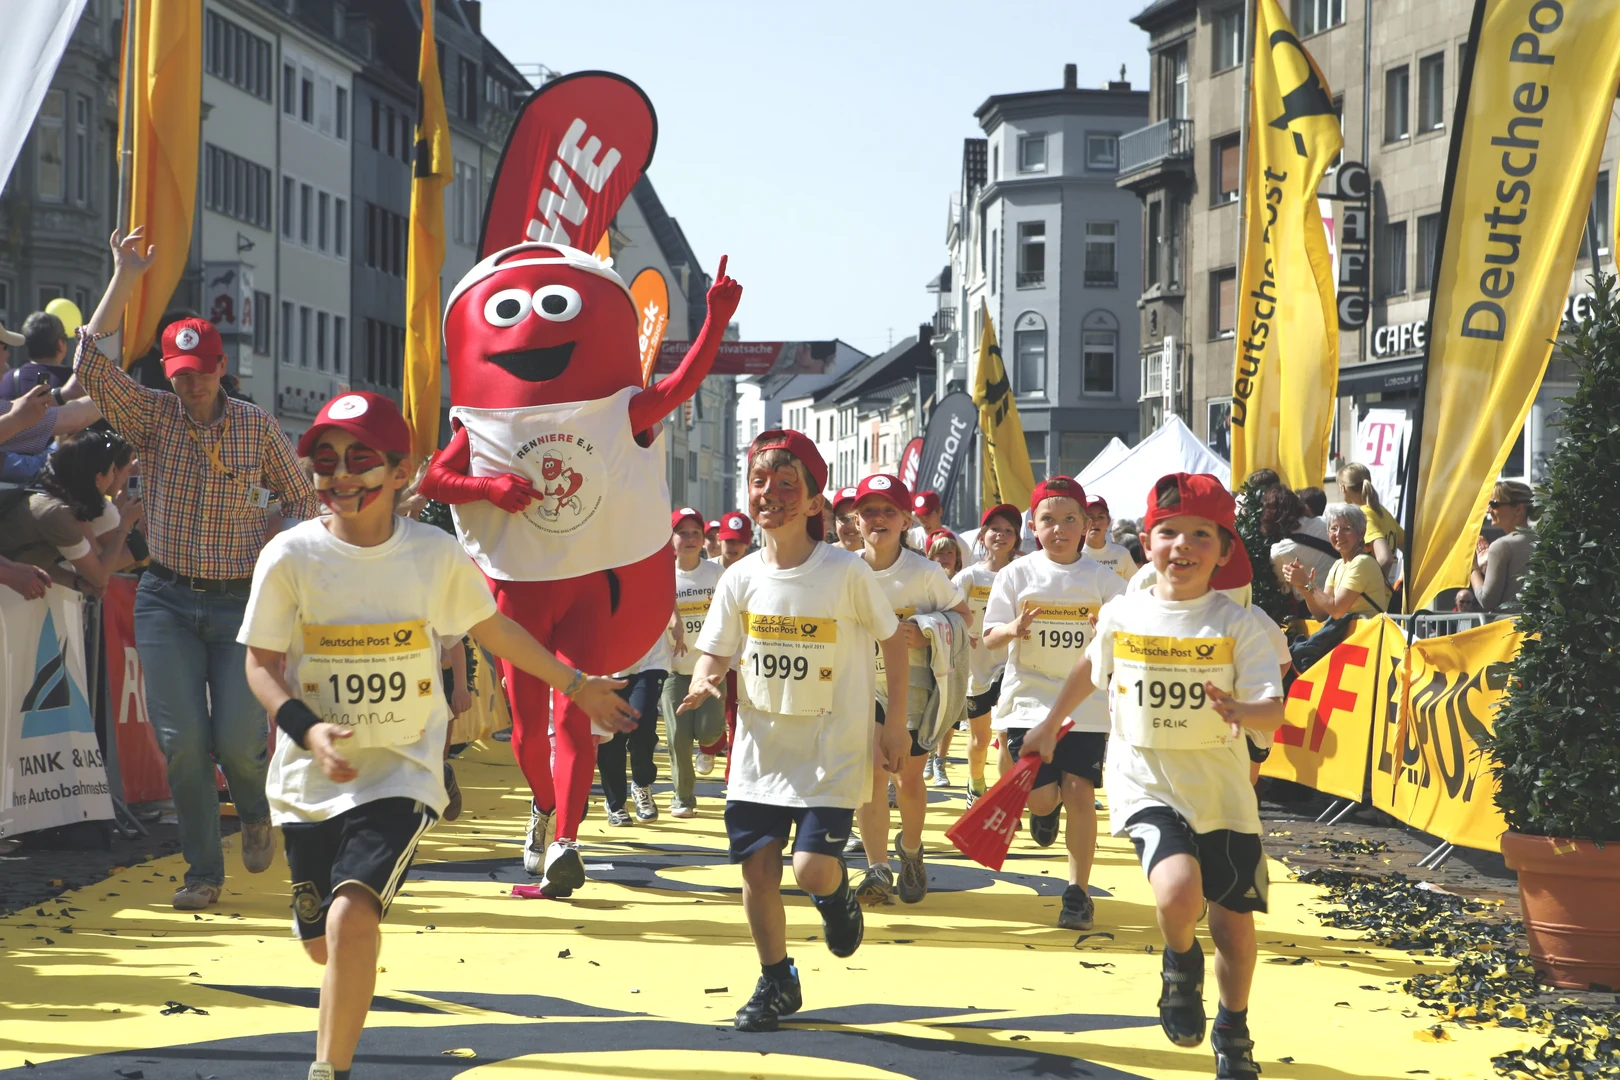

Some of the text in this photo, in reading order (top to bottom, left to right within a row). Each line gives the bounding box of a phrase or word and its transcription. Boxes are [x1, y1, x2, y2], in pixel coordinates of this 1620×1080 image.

[1461, 81, 1549, 341] Deutsche
[639, 300, 659, 361] eck
[719, 344, 773, 354] rivatsache
[516, 433, 594, 460] RENNIERE E.V.
[932, 415, 967, 492] smart
[1040, 608, 1063, 616] eutsche
[319, 636, 390, 647] Deutsche Post
[750, 624, 798, 635] eutsche Post
[1038, 629, 1084, 649] 1999
[1129, 644, 1192, 657] Deutsche Post
[752, 652, 809, 681] 1999
[119, 646, 149, 724] R
[328, 671, 407, 705] 1999
[1134, 679, 1206, 710] 1999
[1152, 717, 1188, 728] ERIK
[19, 751, 65, 777] TANK
[72, 748, 84, 768] &
